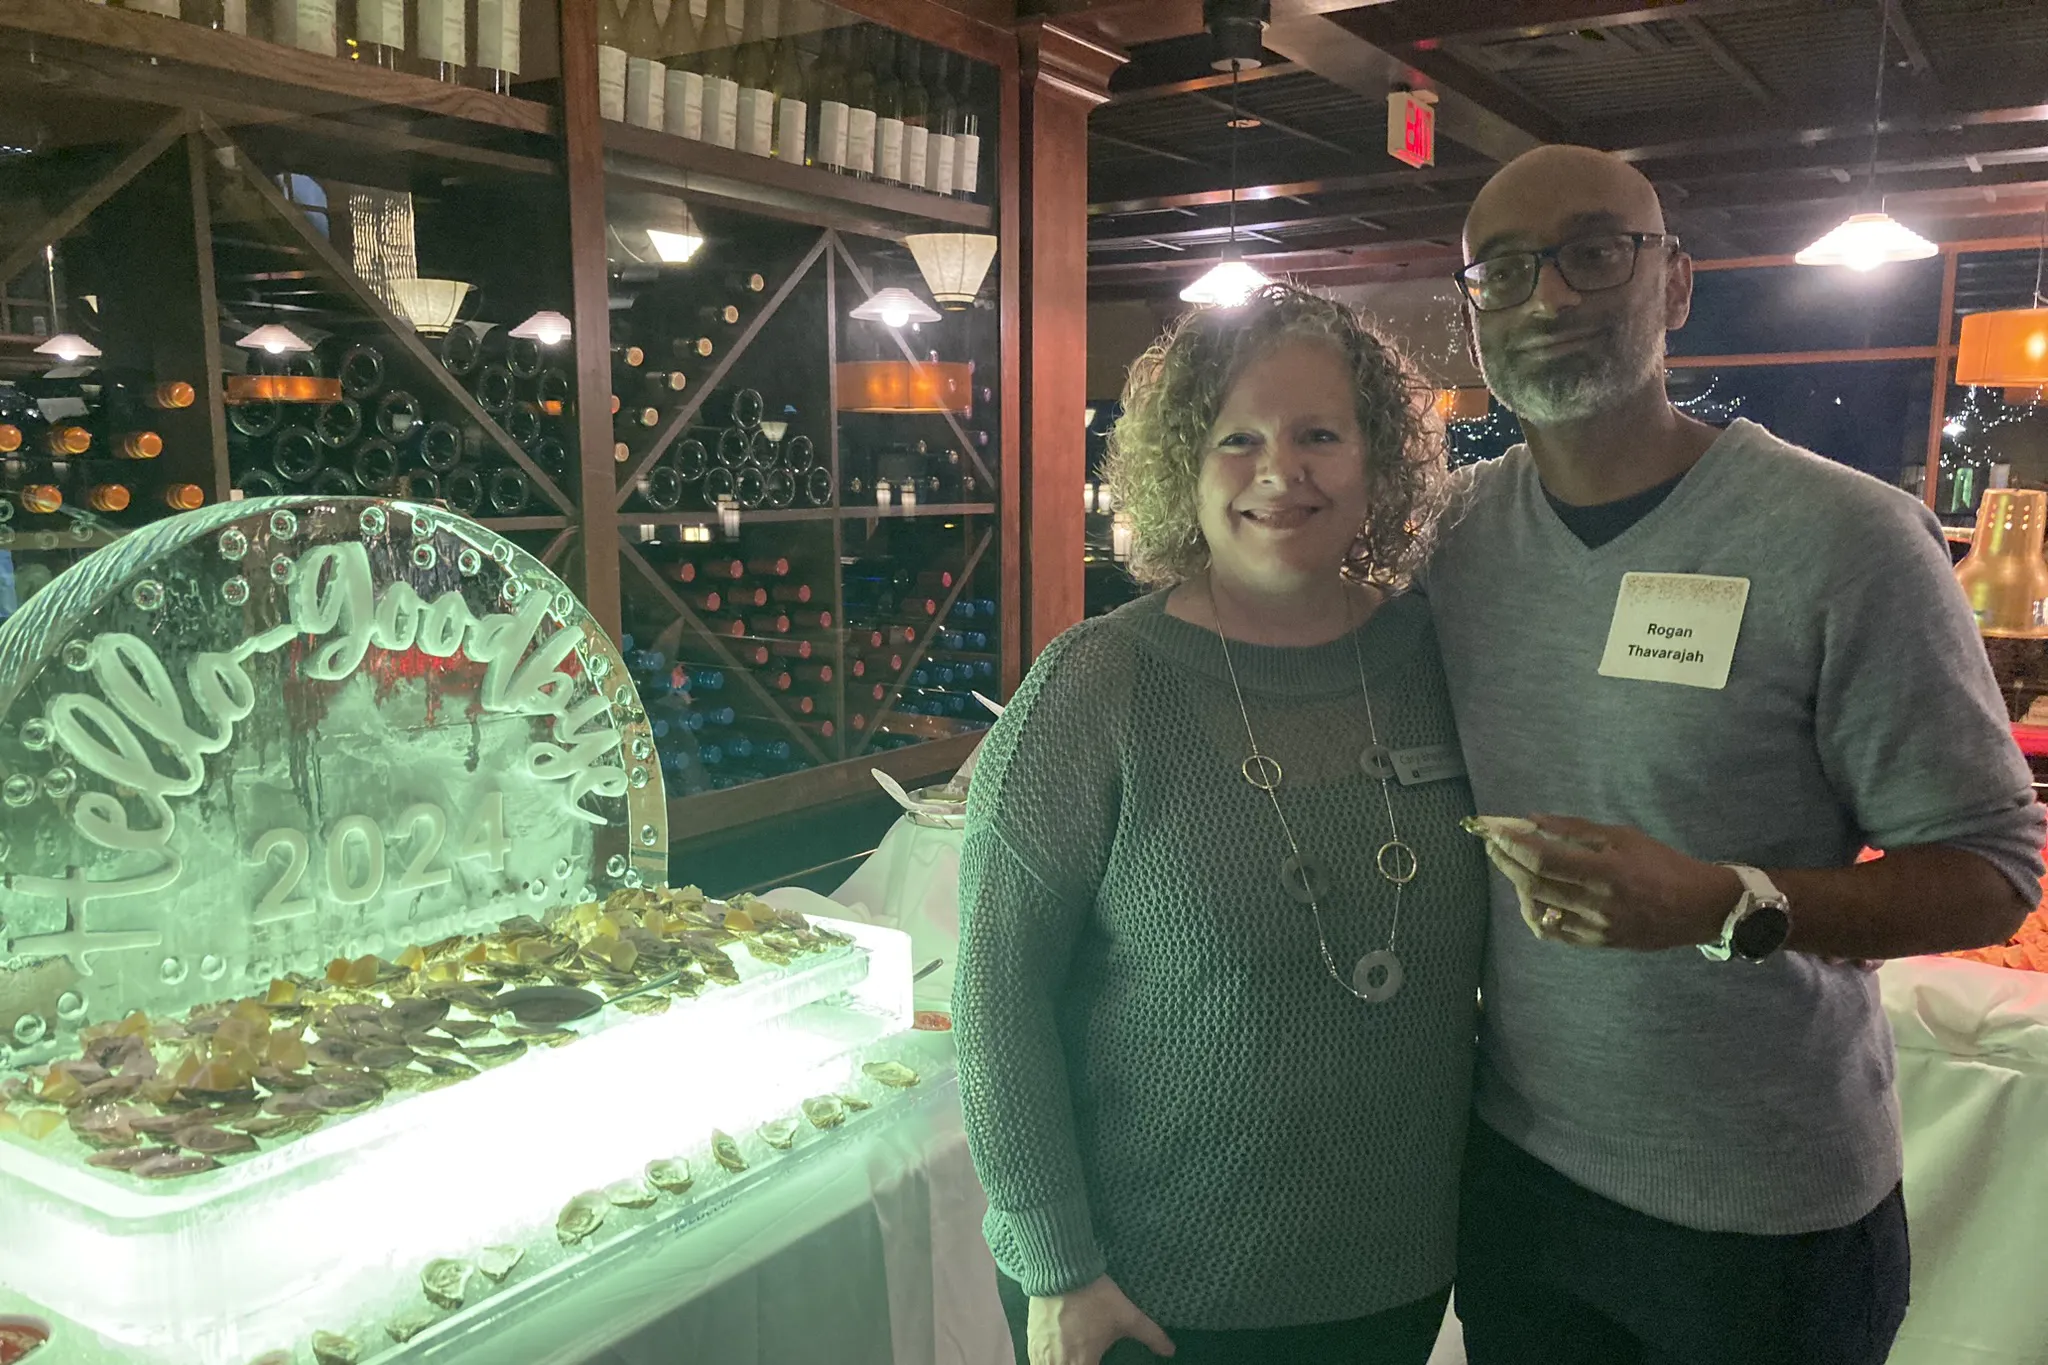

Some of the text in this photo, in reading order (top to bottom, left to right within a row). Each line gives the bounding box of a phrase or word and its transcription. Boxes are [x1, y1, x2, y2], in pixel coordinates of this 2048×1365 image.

[1647, 623, 1693, 639] Rogan
[1628, 644, 1704, 663] Thavarajah
[246, 791, 511, 924] 2024
